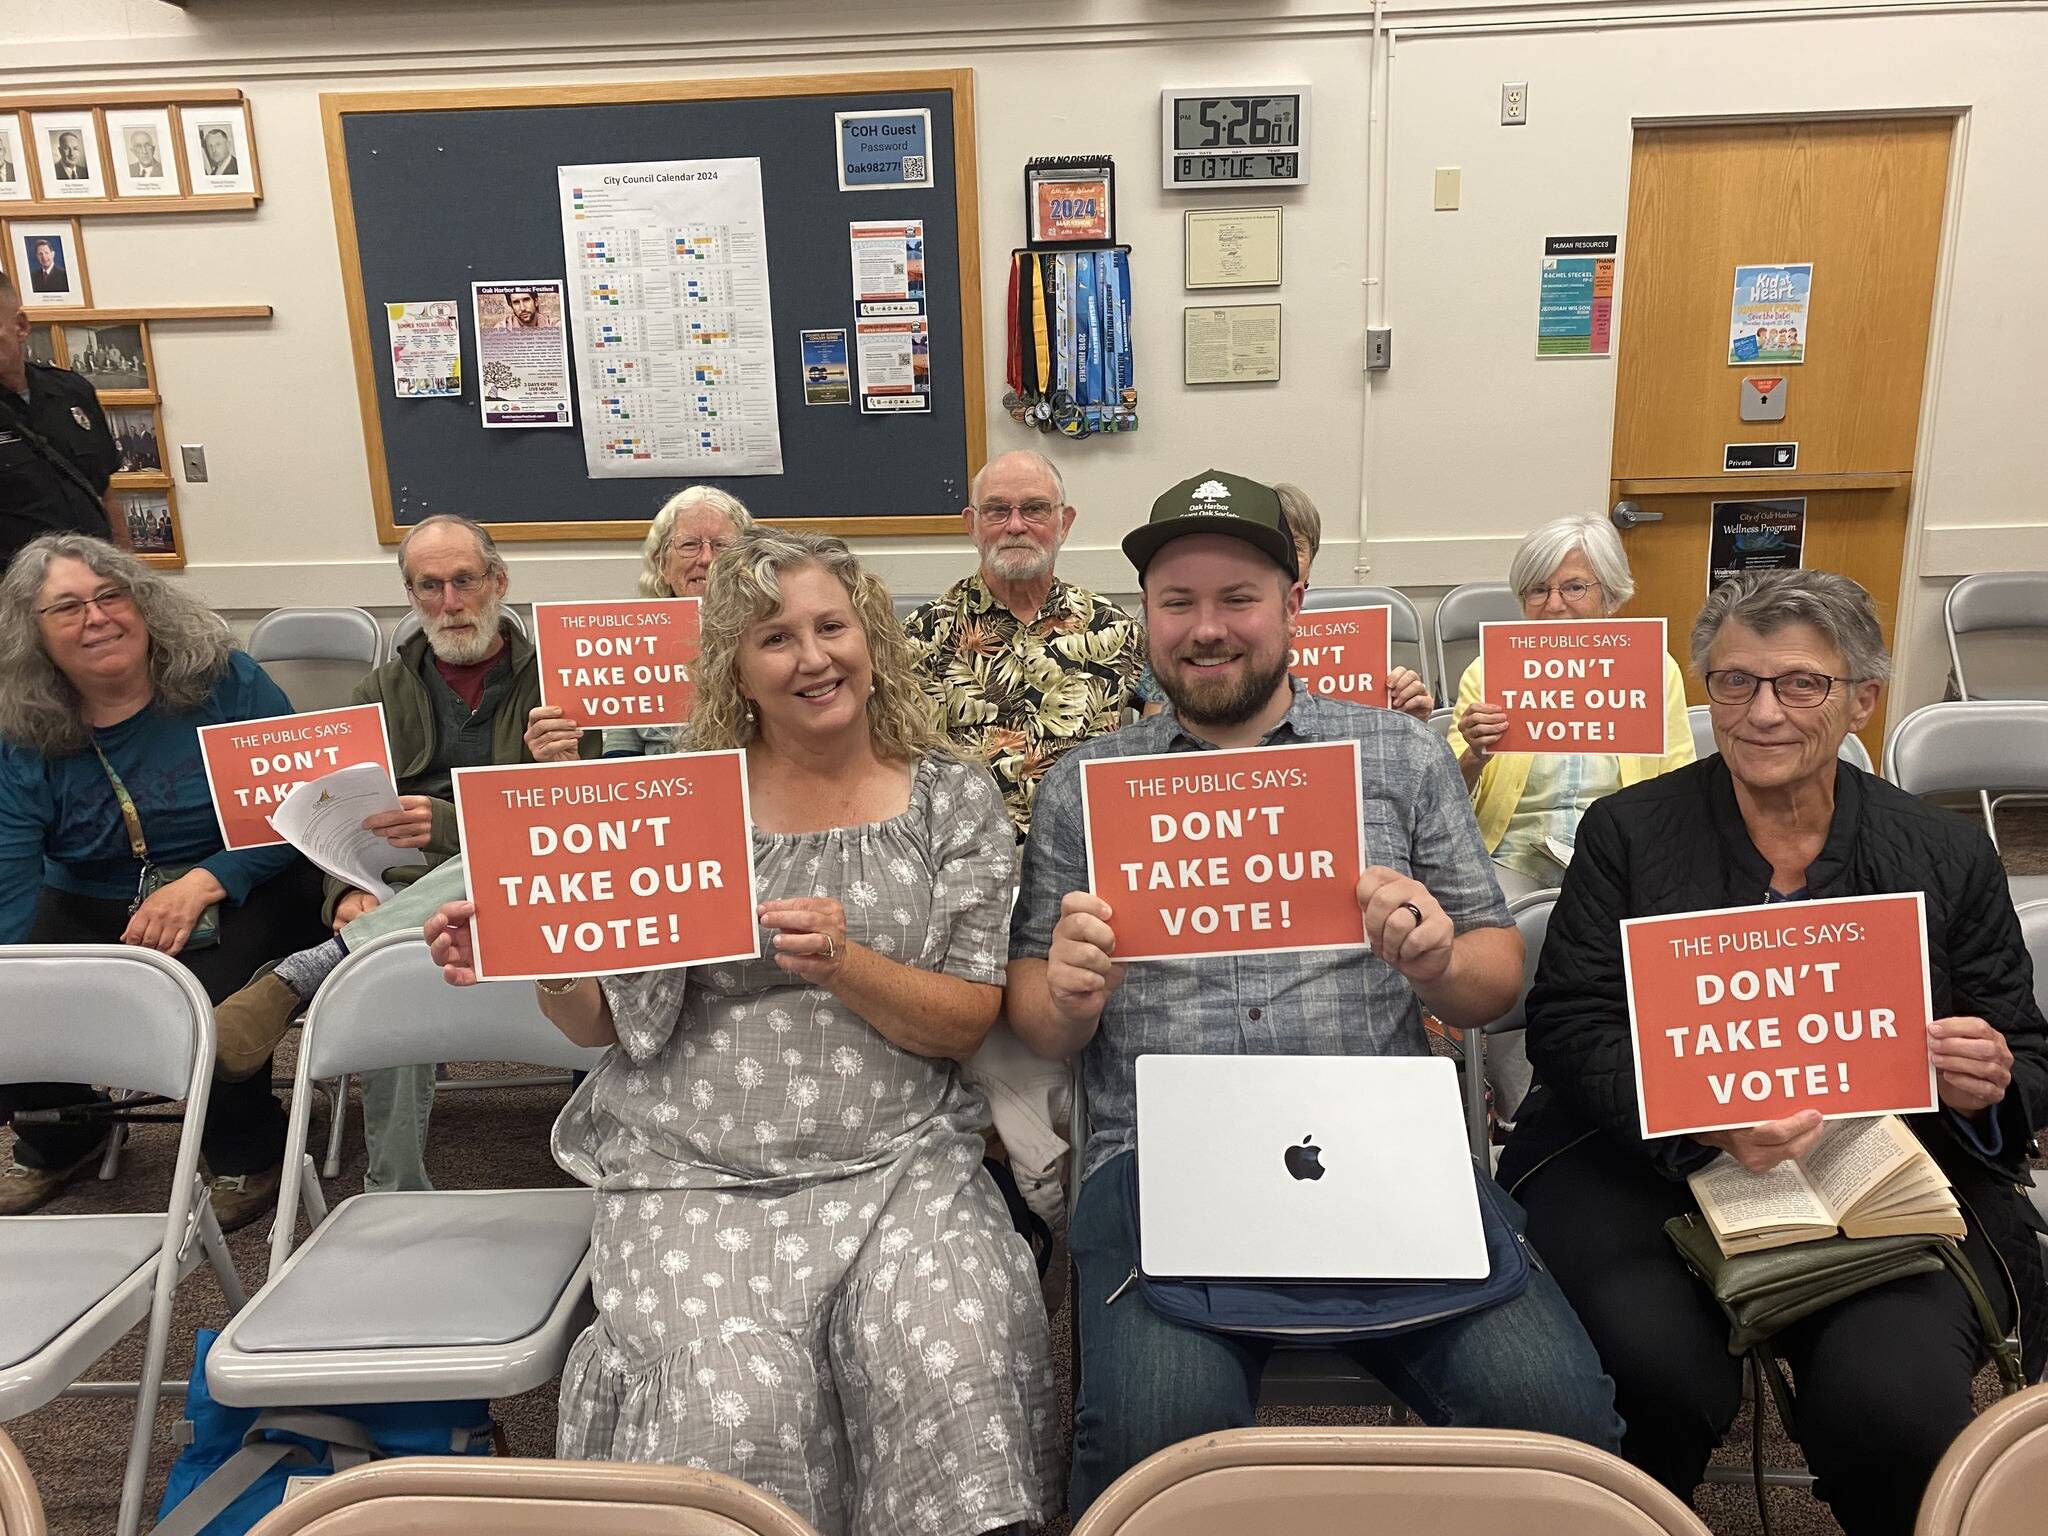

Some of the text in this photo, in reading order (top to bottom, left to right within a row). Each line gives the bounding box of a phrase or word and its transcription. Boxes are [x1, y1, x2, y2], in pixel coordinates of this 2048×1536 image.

[851, 124, 917, 138] COH Guest
[1200, 100, 1271, 146] 5:26
[860, 140, 908, 152] Password
[1071, 154, 1112, 163] DISTANCE
[1183, 159, 1192, 175] 8
[1202, 158, 1216, 178] 13
[1220, 156, 1255, 178] TUE
[604, 172, 718, 186] City Council Calendar 2024
[1050, 198, 1096, 220] 2024
[1756, 274, 1780, 288] Kid
[1750, 284, 1795, 302] Heart
[1204, 503, 1229, 511] Harbor
[1740, 510, 1798, 522] City of Oak Harbor
[1723, 523, 1797, 534] Wellness Program
[561, 613, 671, 628] THE PUBLIC SAYS:
[1296, 622, 1359, 637] BLIC SAYS:
[576, 636, 657, 657] DON'T
[1509, 634, 1631, 648] THE PUBLIC SAYS:
[1288, 646, 1344, 667] ON'T
[558, 664, 690, 686] TAKE OUR
[1524, 659, 1614, 679] DON'T
[1318, 673, 1373, 694] OUR
[1502, 689, 1646, 709] TAKE OUR
[231, 722, 352, 749] THE PUBLIC SAYS:
[250, 746, 339, 776] DON'T
[502, 777, 693, 808] THE PUBLIC SAYS:
[1126, 768, 1307, 798] THE PUBLIC SAYS:
[1150, 806, 1285, 843] DON'T
[529, 817, 671, 856] DON'T
[1120, 850, 1335, 891] TAKE OUR
[499, 860, 724, 906] TAKE OUR
[1669, 922, 1865, 958] THE PUBLIC SAYS:
[1696, 962, 1840, 1005] DON'T
[1665, 1008, 1898, 1058] TAKE OUR
